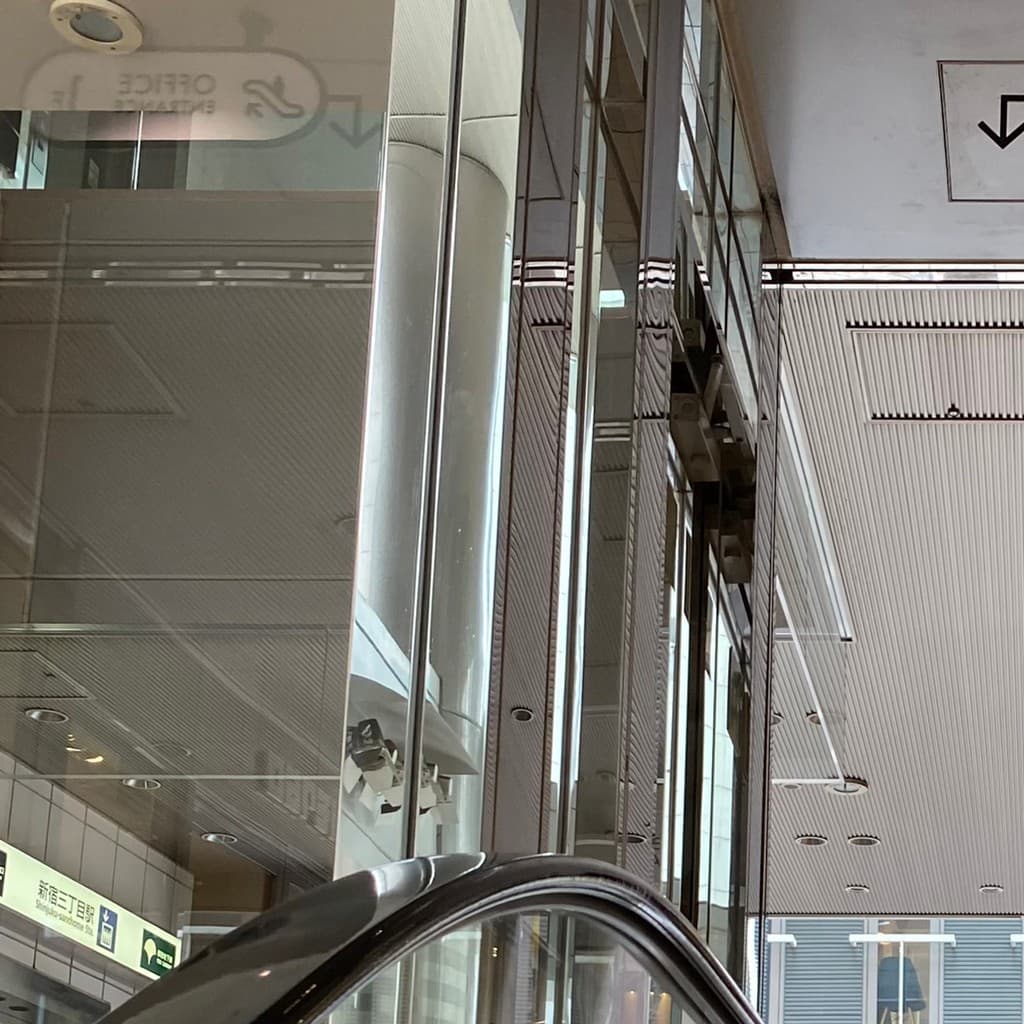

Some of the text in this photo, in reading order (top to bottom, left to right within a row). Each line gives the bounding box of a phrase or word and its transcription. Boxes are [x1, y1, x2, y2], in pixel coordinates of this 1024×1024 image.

[37, 880, 95, 925] 新宿三丁目駅
